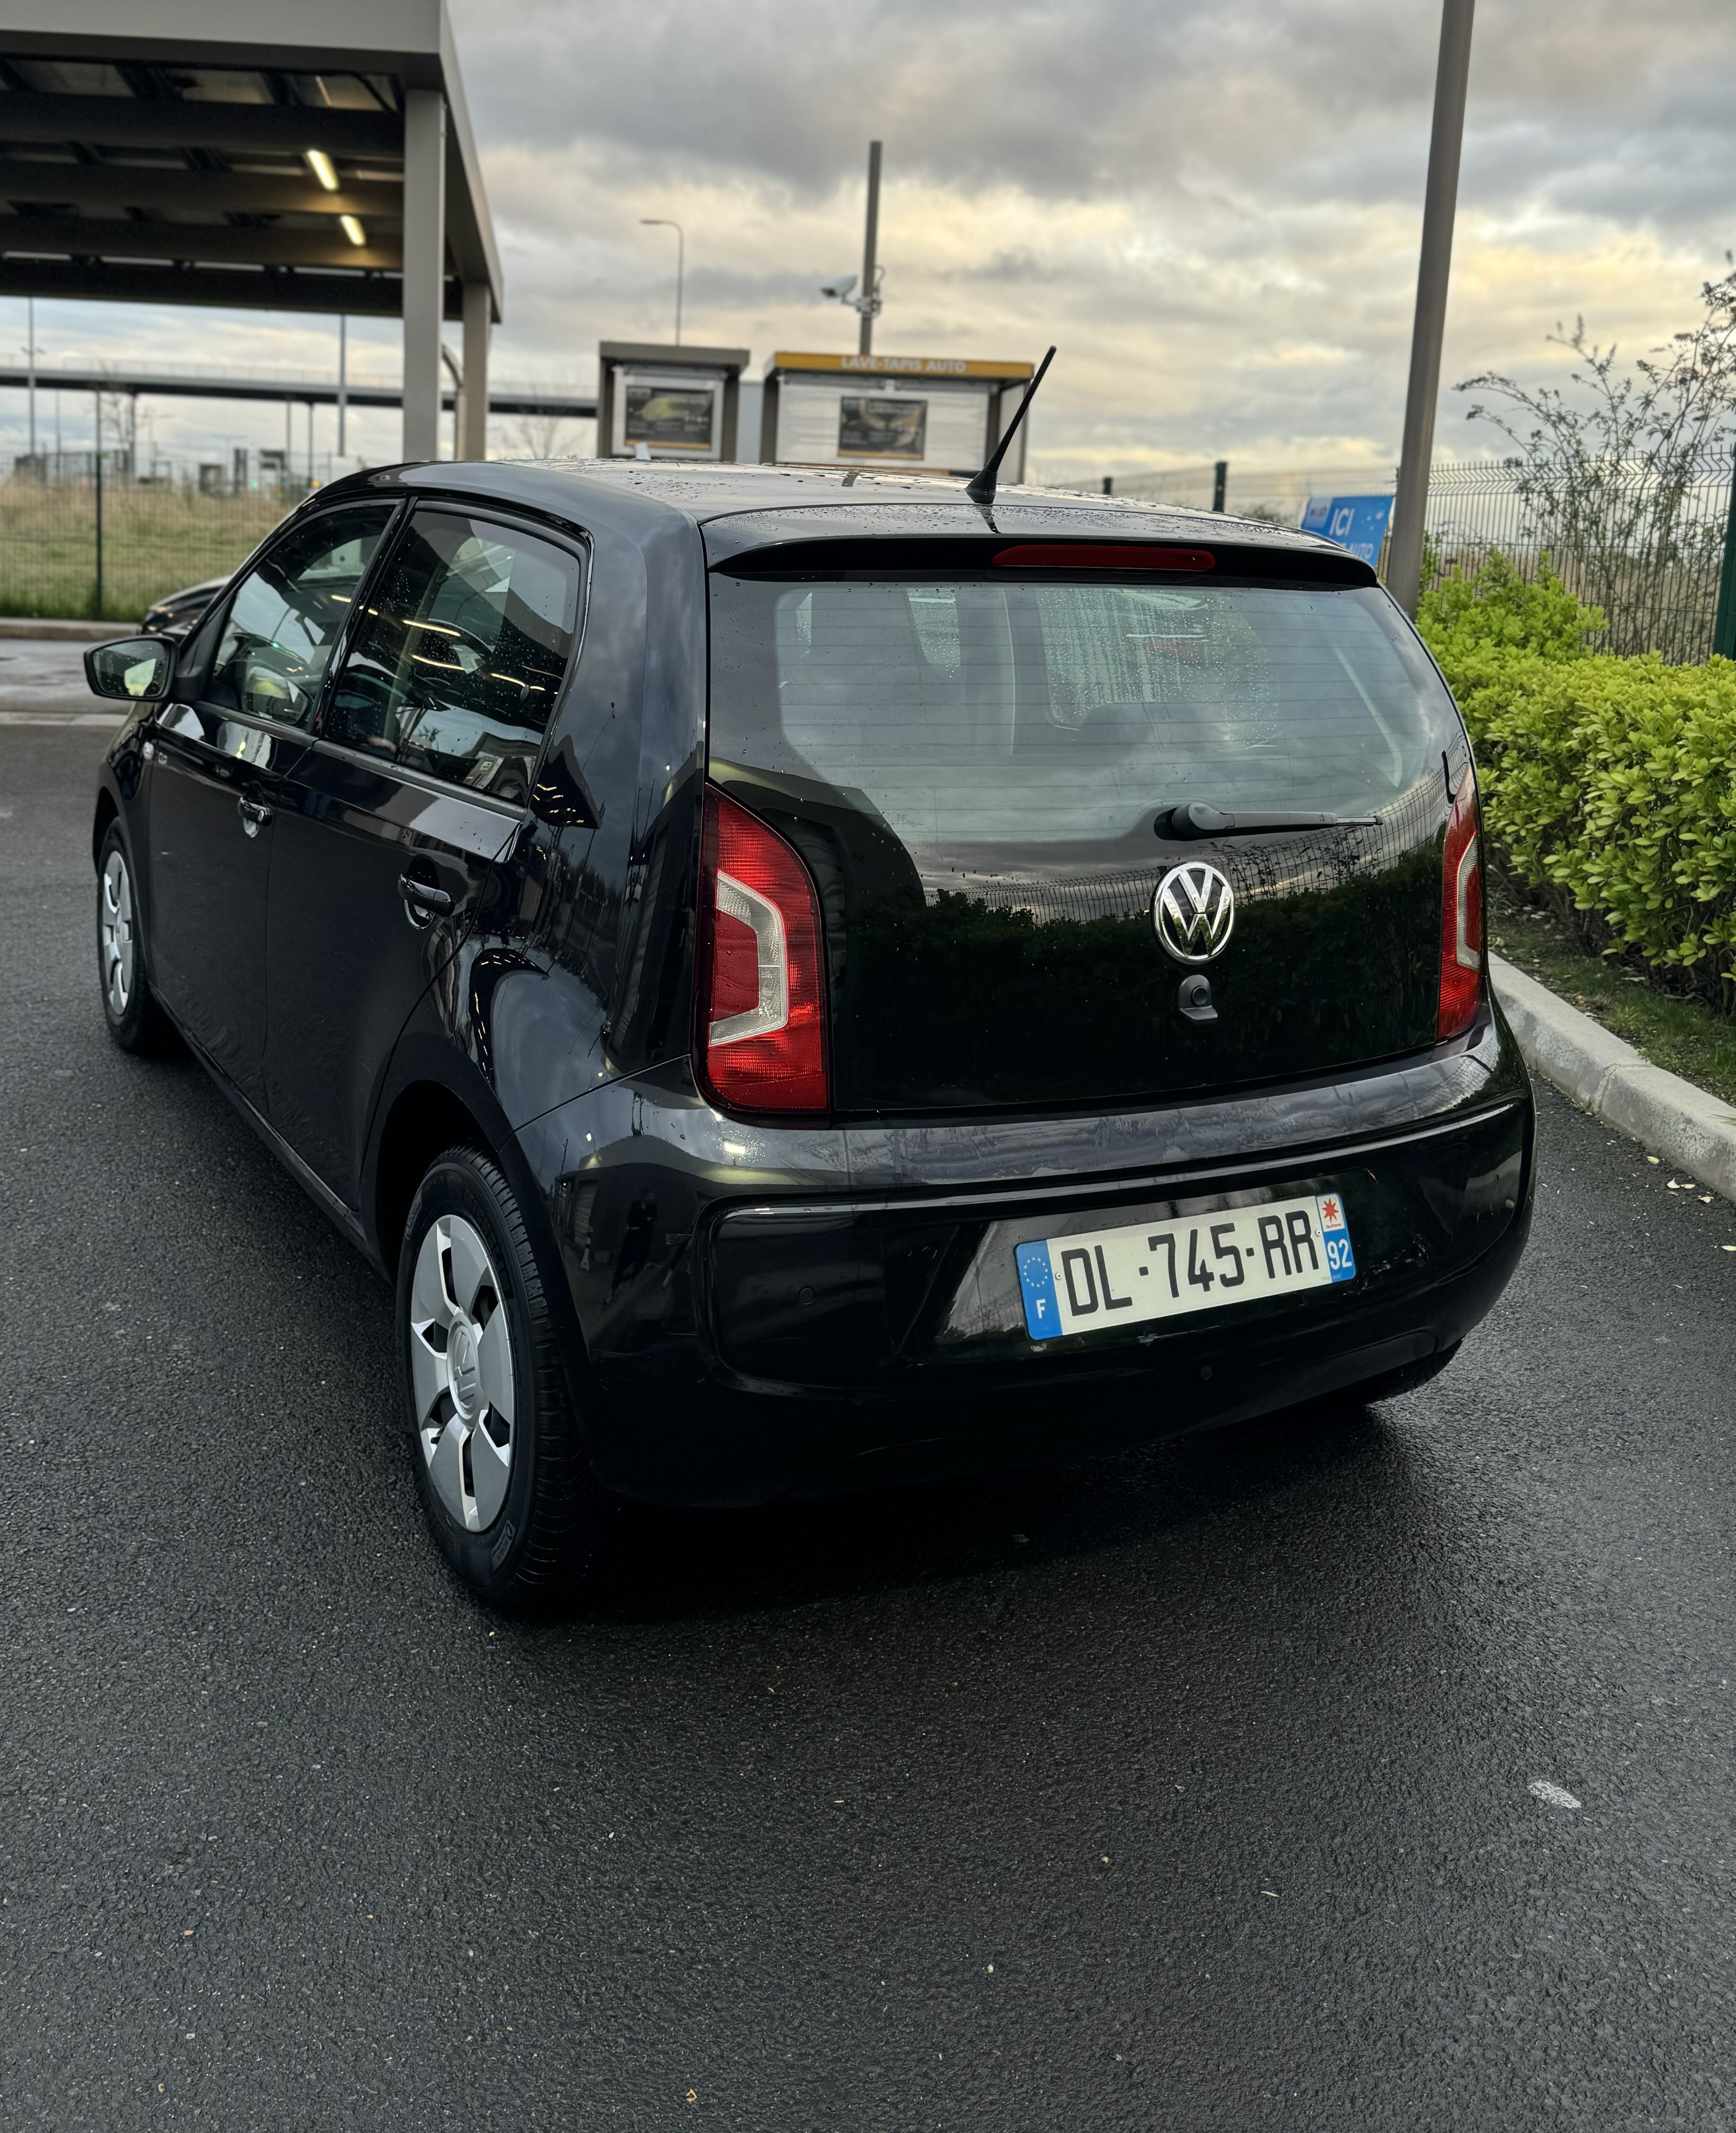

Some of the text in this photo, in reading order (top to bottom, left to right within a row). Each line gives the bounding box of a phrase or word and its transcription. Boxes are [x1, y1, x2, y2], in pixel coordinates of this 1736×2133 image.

[841, 356, 966, 373] LAVE-TAPIS AUTO
[1329, 508, 1355, 536] ICI
[1348, 542, 1374, 560] AUTO
[1154, 862, 1234, 964] VW
[1328, 1239, 1352, 1270] 92
[1036, 1298, 1046, 1318] F
